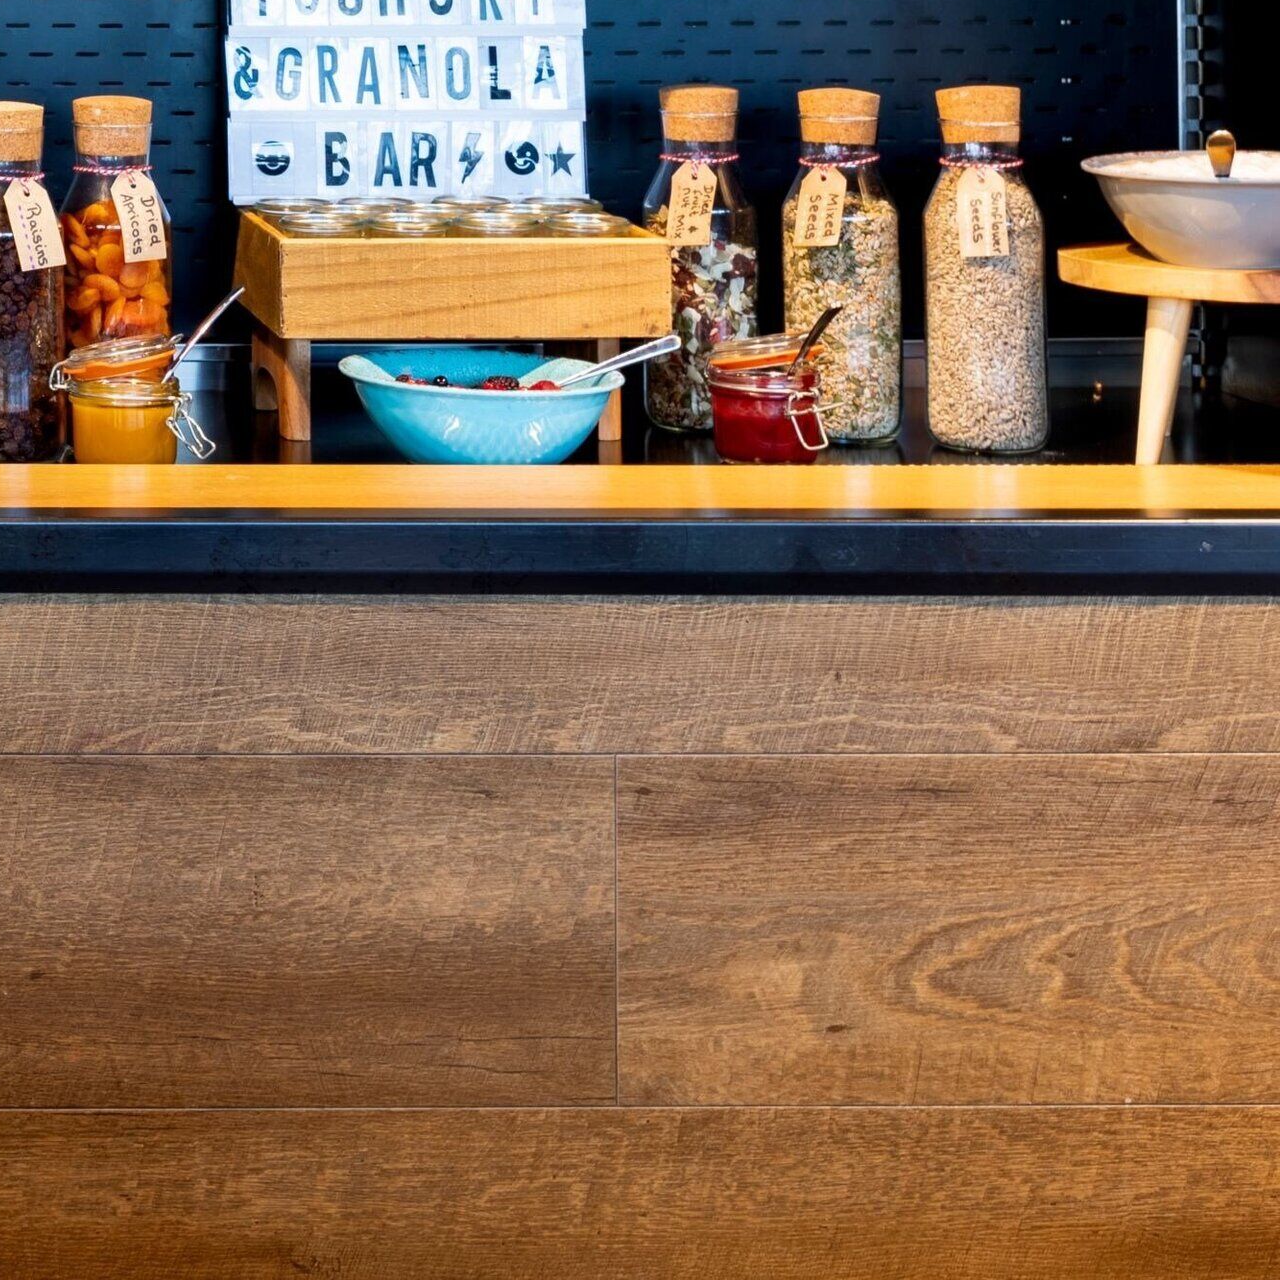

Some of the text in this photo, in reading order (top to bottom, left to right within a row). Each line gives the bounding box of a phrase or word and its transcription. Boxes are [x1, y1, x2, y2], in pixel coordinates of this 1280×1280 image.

[324, 131, 437, 188] BAR
[141, 195, 161, 246] Dried
[700, 185, 714, 216] Dried
[805, 195, 822, 239] Seeds
[822, 193, 839, 237] Mixed
[970, 198, 983, 243] Seeds
[26, 203, 48, 266] Raisins
